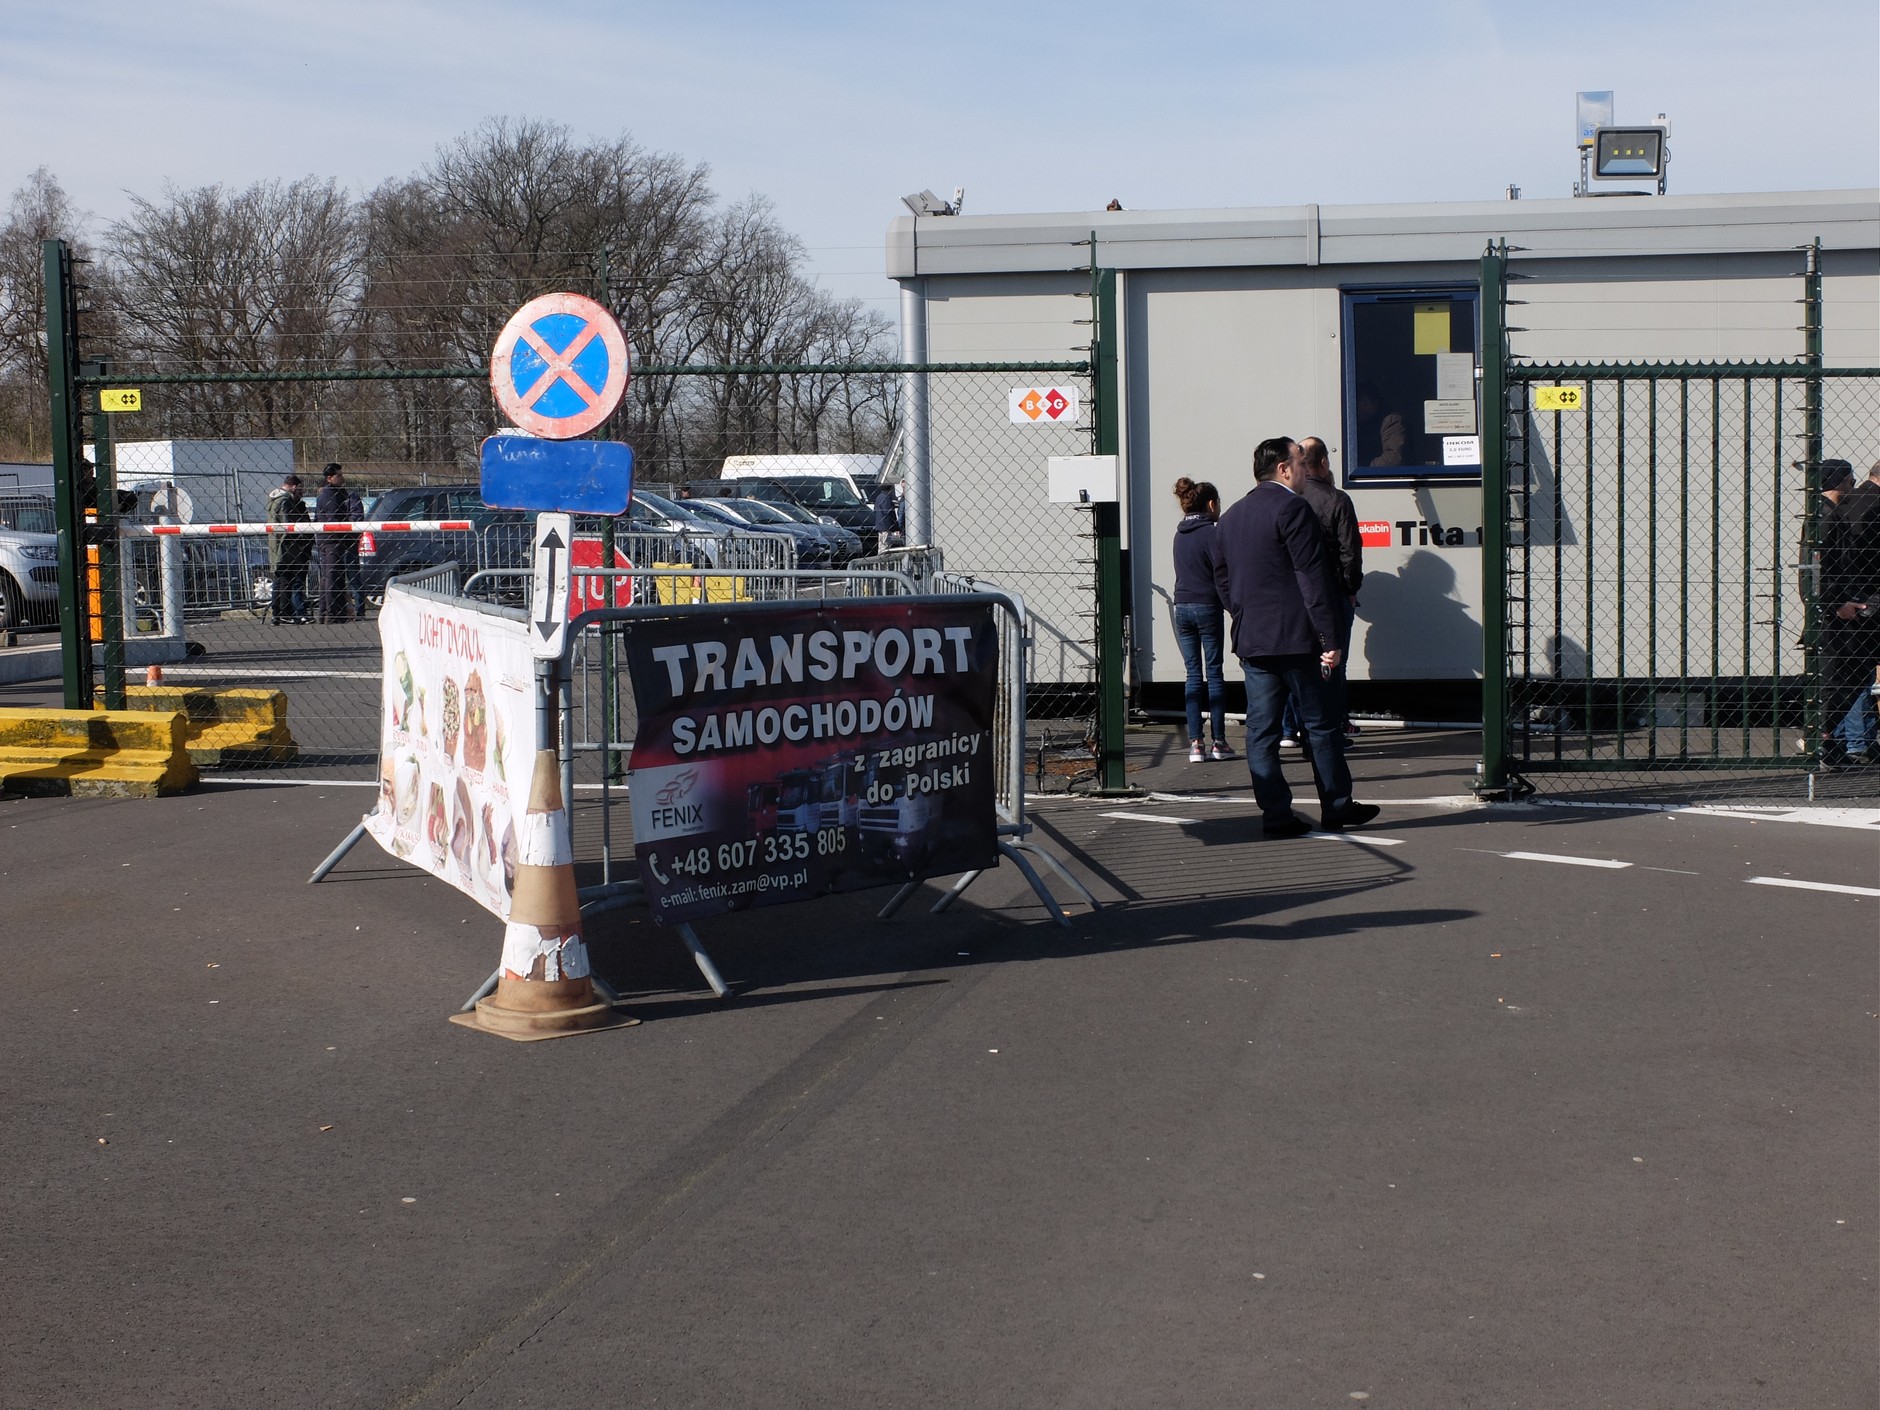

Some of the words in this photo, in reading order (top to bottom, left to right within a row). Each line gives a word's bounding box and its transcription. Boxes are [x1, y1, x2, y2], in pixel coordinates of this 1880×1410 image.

[1026, 400, 1034, 410] B
[1053, 398, 1064, 410] G
[418, 611, 445, 649] LIGHT
[652, 626, 973, 698] TRANSPORT
[671, 698, 935, 755] SAMOCHODÓW
[854, 754, 866, 772] z
[879, 732, 981, 769] zagranicy
[866, 780, 894, 804] do
[906, 761, 970, 797] Polski
[651, 804, 703, 829] FENIX
[671, 847, 711, 876] +48
[717, 839, 757, 871] 607
[764, 832, 810, 863] 335
[817, 826, 846, 855] 805
[660, 887, 699, 908] e-mail:
[699, 868, 808, 901] fenix.zam@vp.pl
